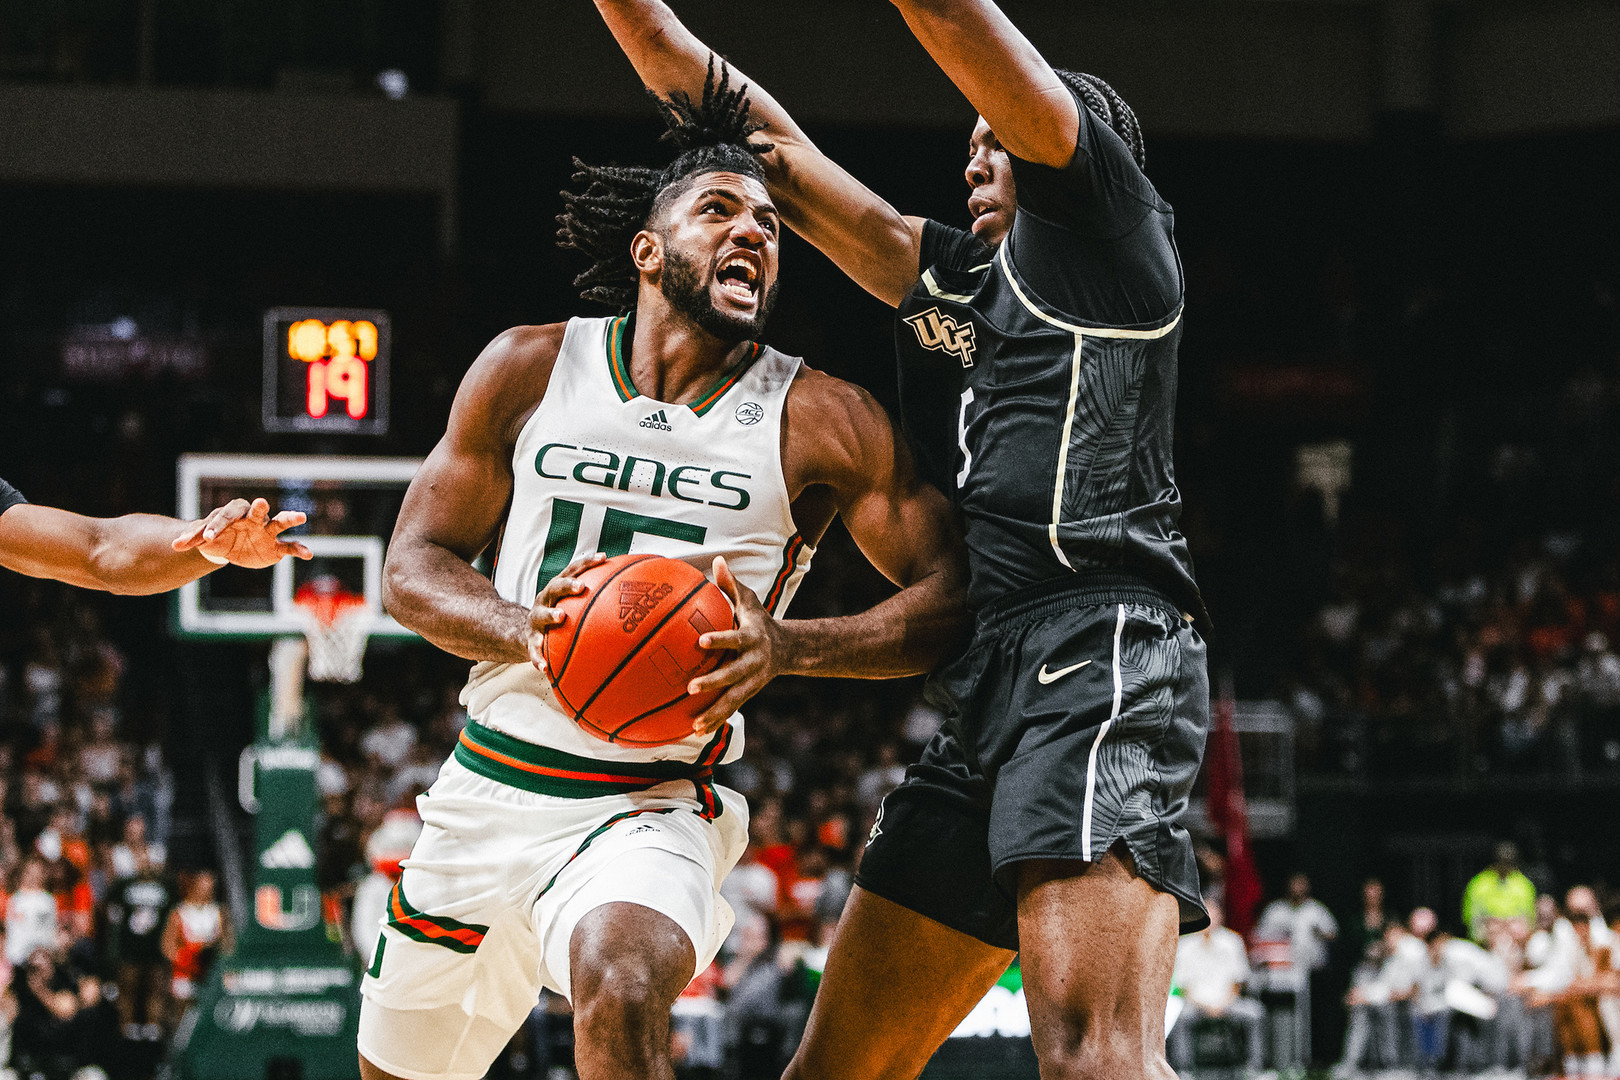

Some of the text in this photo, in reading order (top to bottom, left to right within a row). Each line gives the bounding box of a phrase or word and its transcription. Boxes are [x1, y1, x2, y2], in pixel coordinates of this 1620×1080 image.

[905, 308, 975, 367] UCF
[307, 355, 368, 420] 19
[639, 420, 672, 432] adidas
[622, 582, 673, 633] adidas
